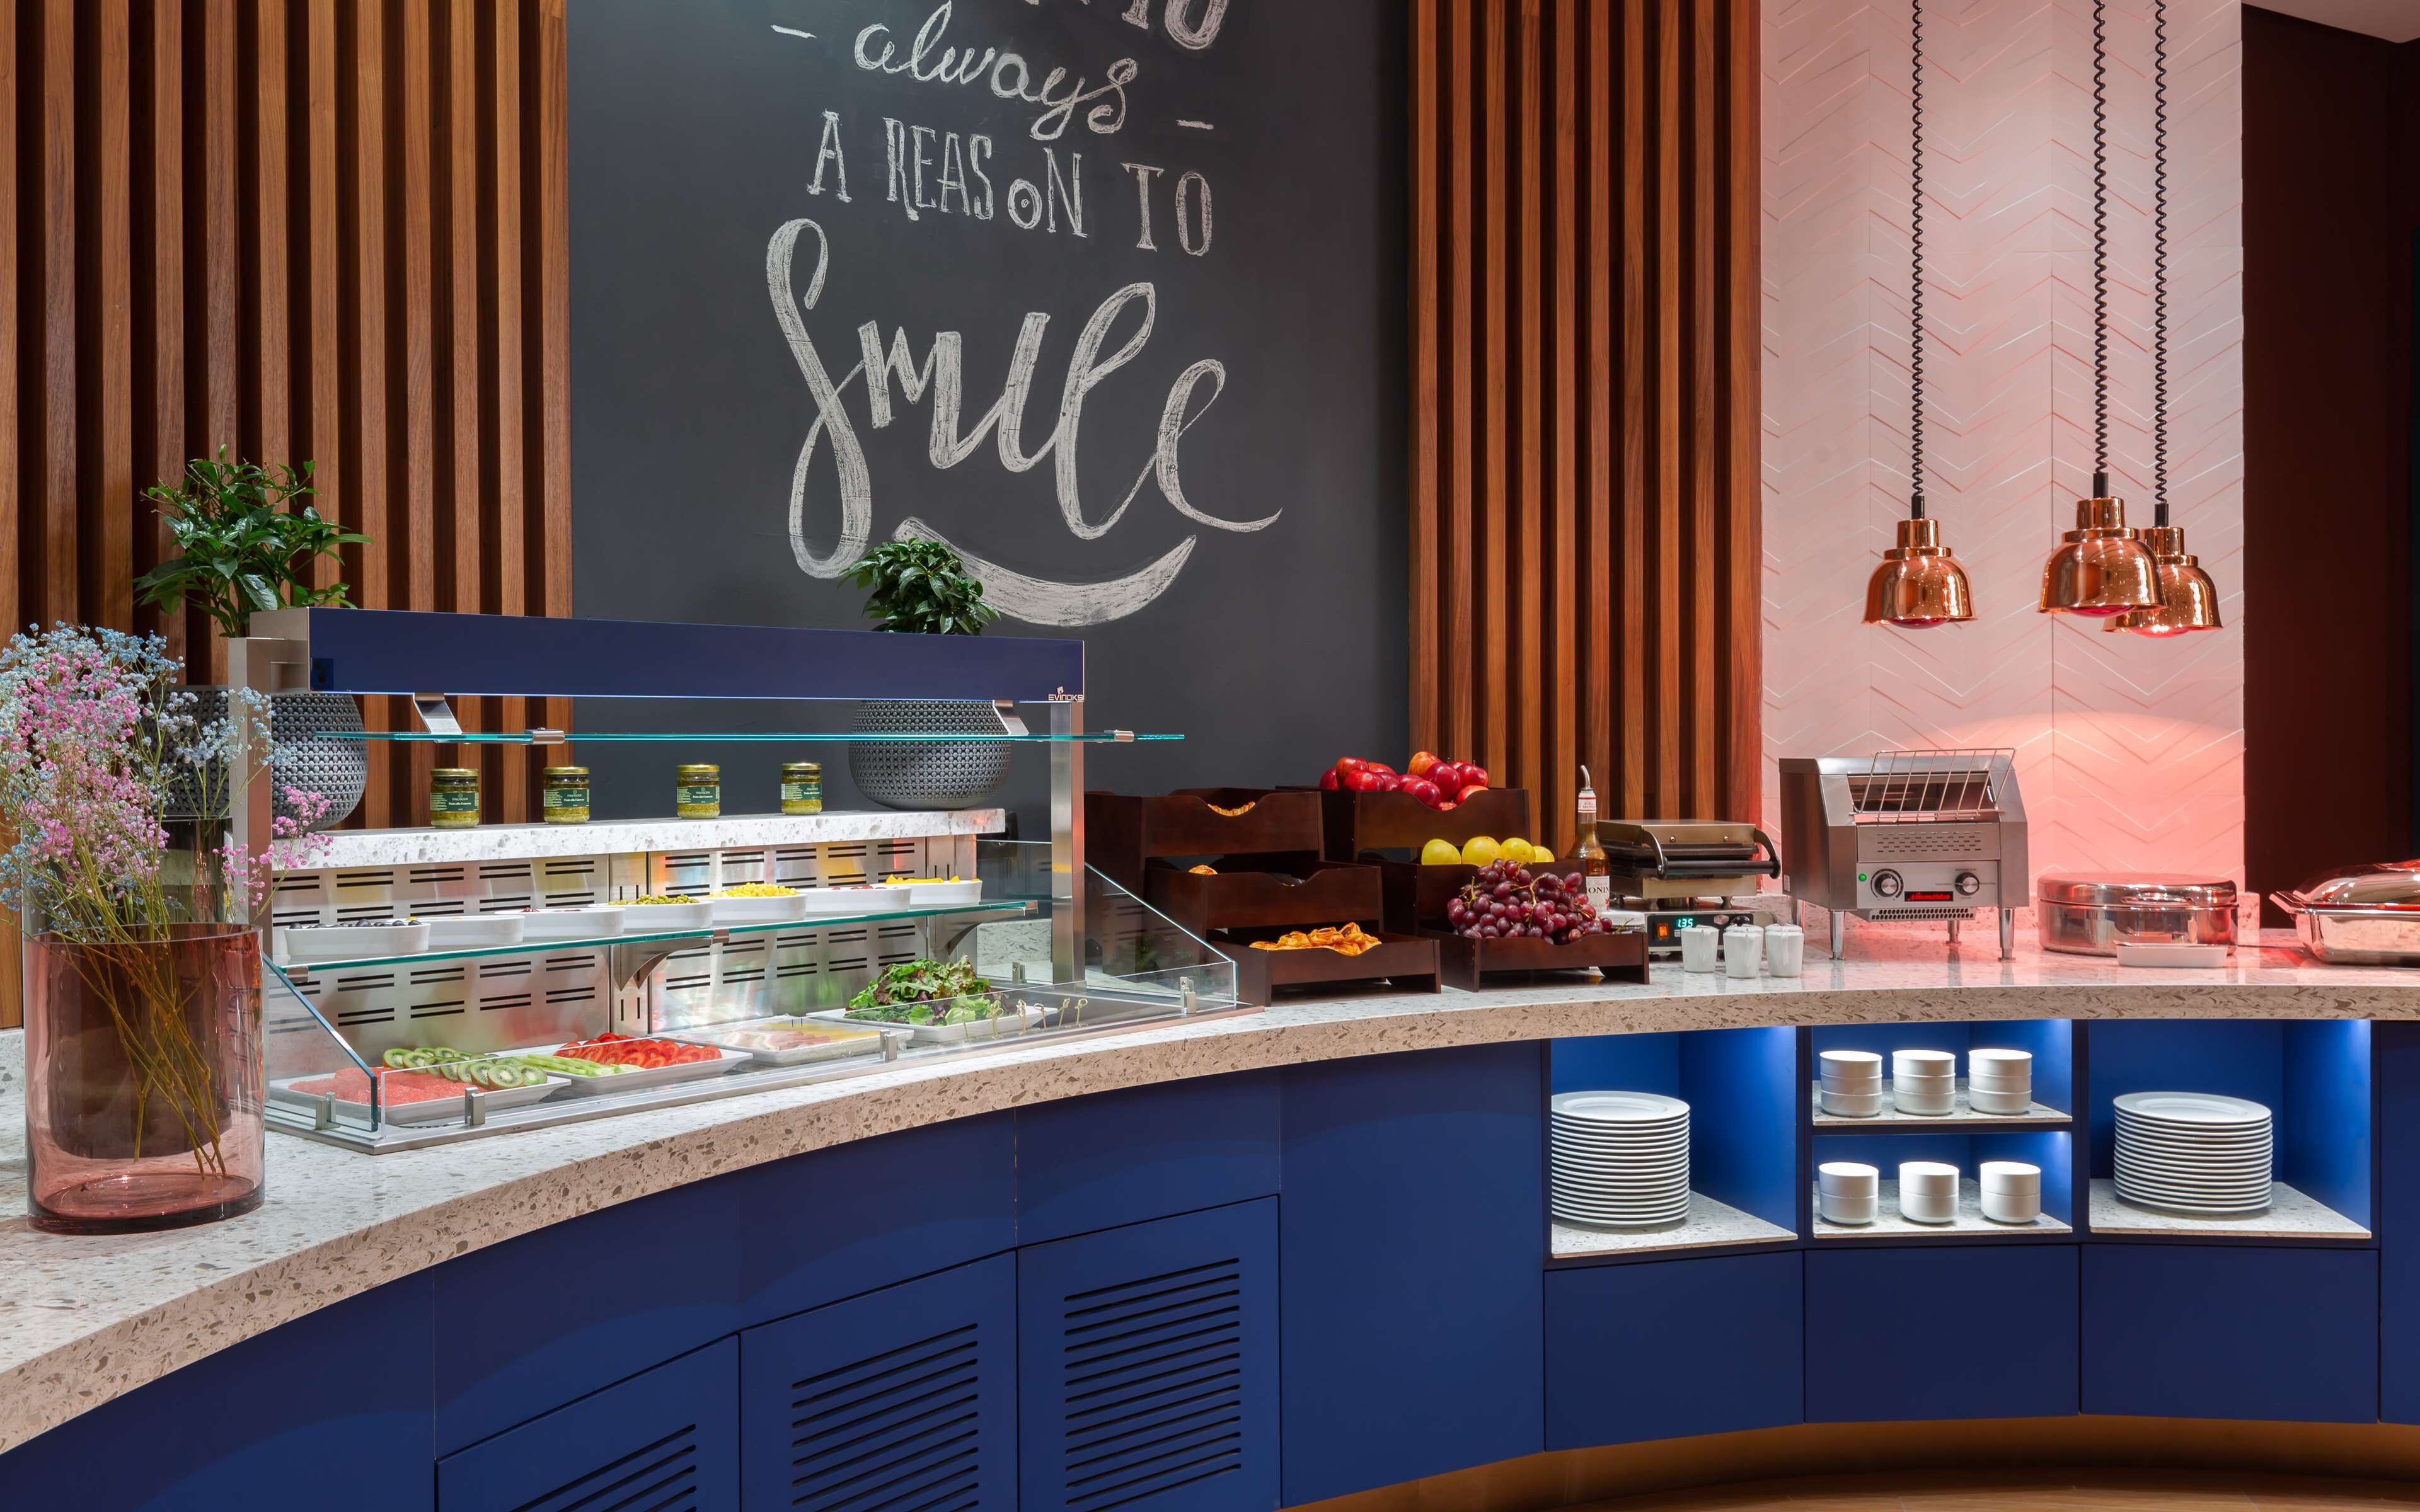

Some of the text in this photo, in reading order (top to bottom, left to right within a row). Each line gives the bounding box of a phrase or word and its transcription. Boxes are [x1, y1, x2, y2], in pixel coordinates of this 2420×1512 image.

[854, 0, 1137, 140] always
[807, 109, 1213, 256] A REASON TO
[766, 218, 1282, 579] Smile
